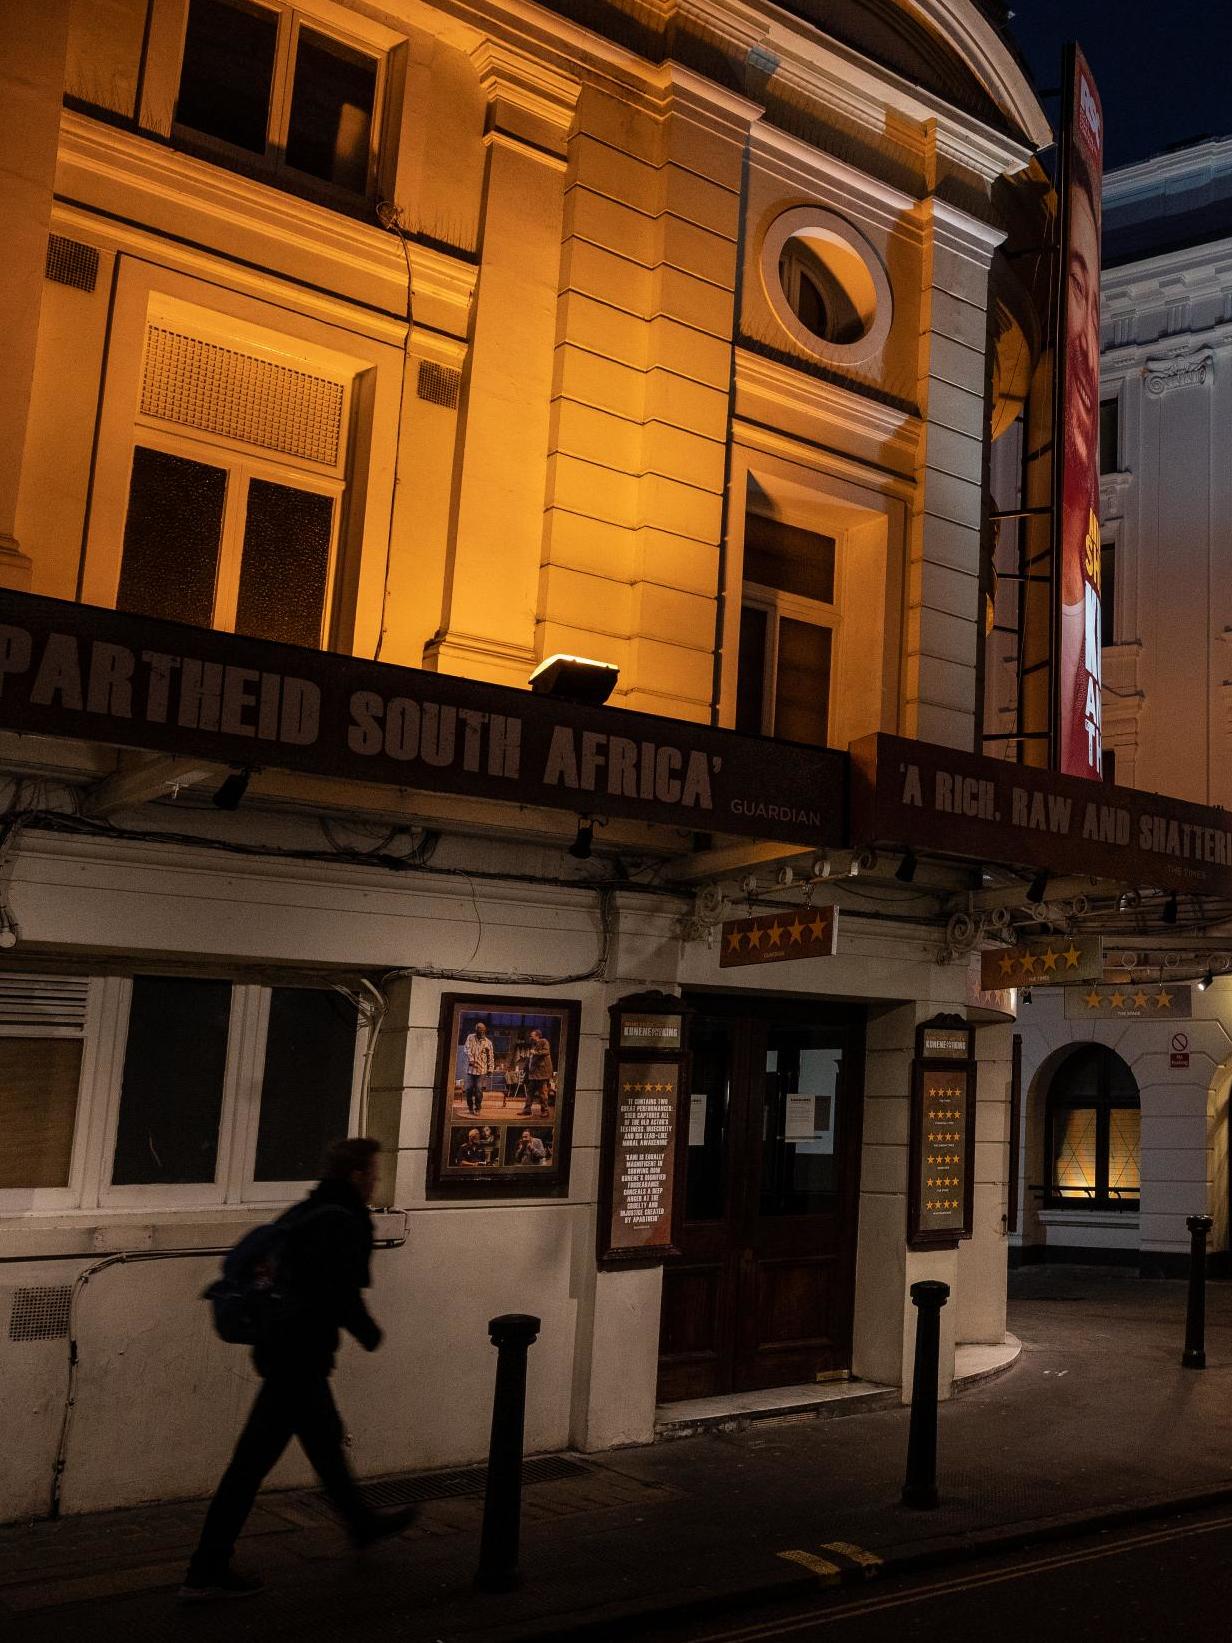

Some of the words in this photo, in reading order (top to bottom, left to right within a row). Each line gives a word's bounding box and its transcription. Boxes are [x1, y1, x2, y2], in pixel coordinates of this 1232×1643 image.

[347, 690, 521, 780] SOUTH
[730, 798, 823, 826] GUARDIAN
[1012, 787, 1072, 835] RAW
[1082, 802, 1131, 846] AND
[624, 1026, 652, 1037] KUNENE
[662, 1027, 678, 1037] KING
